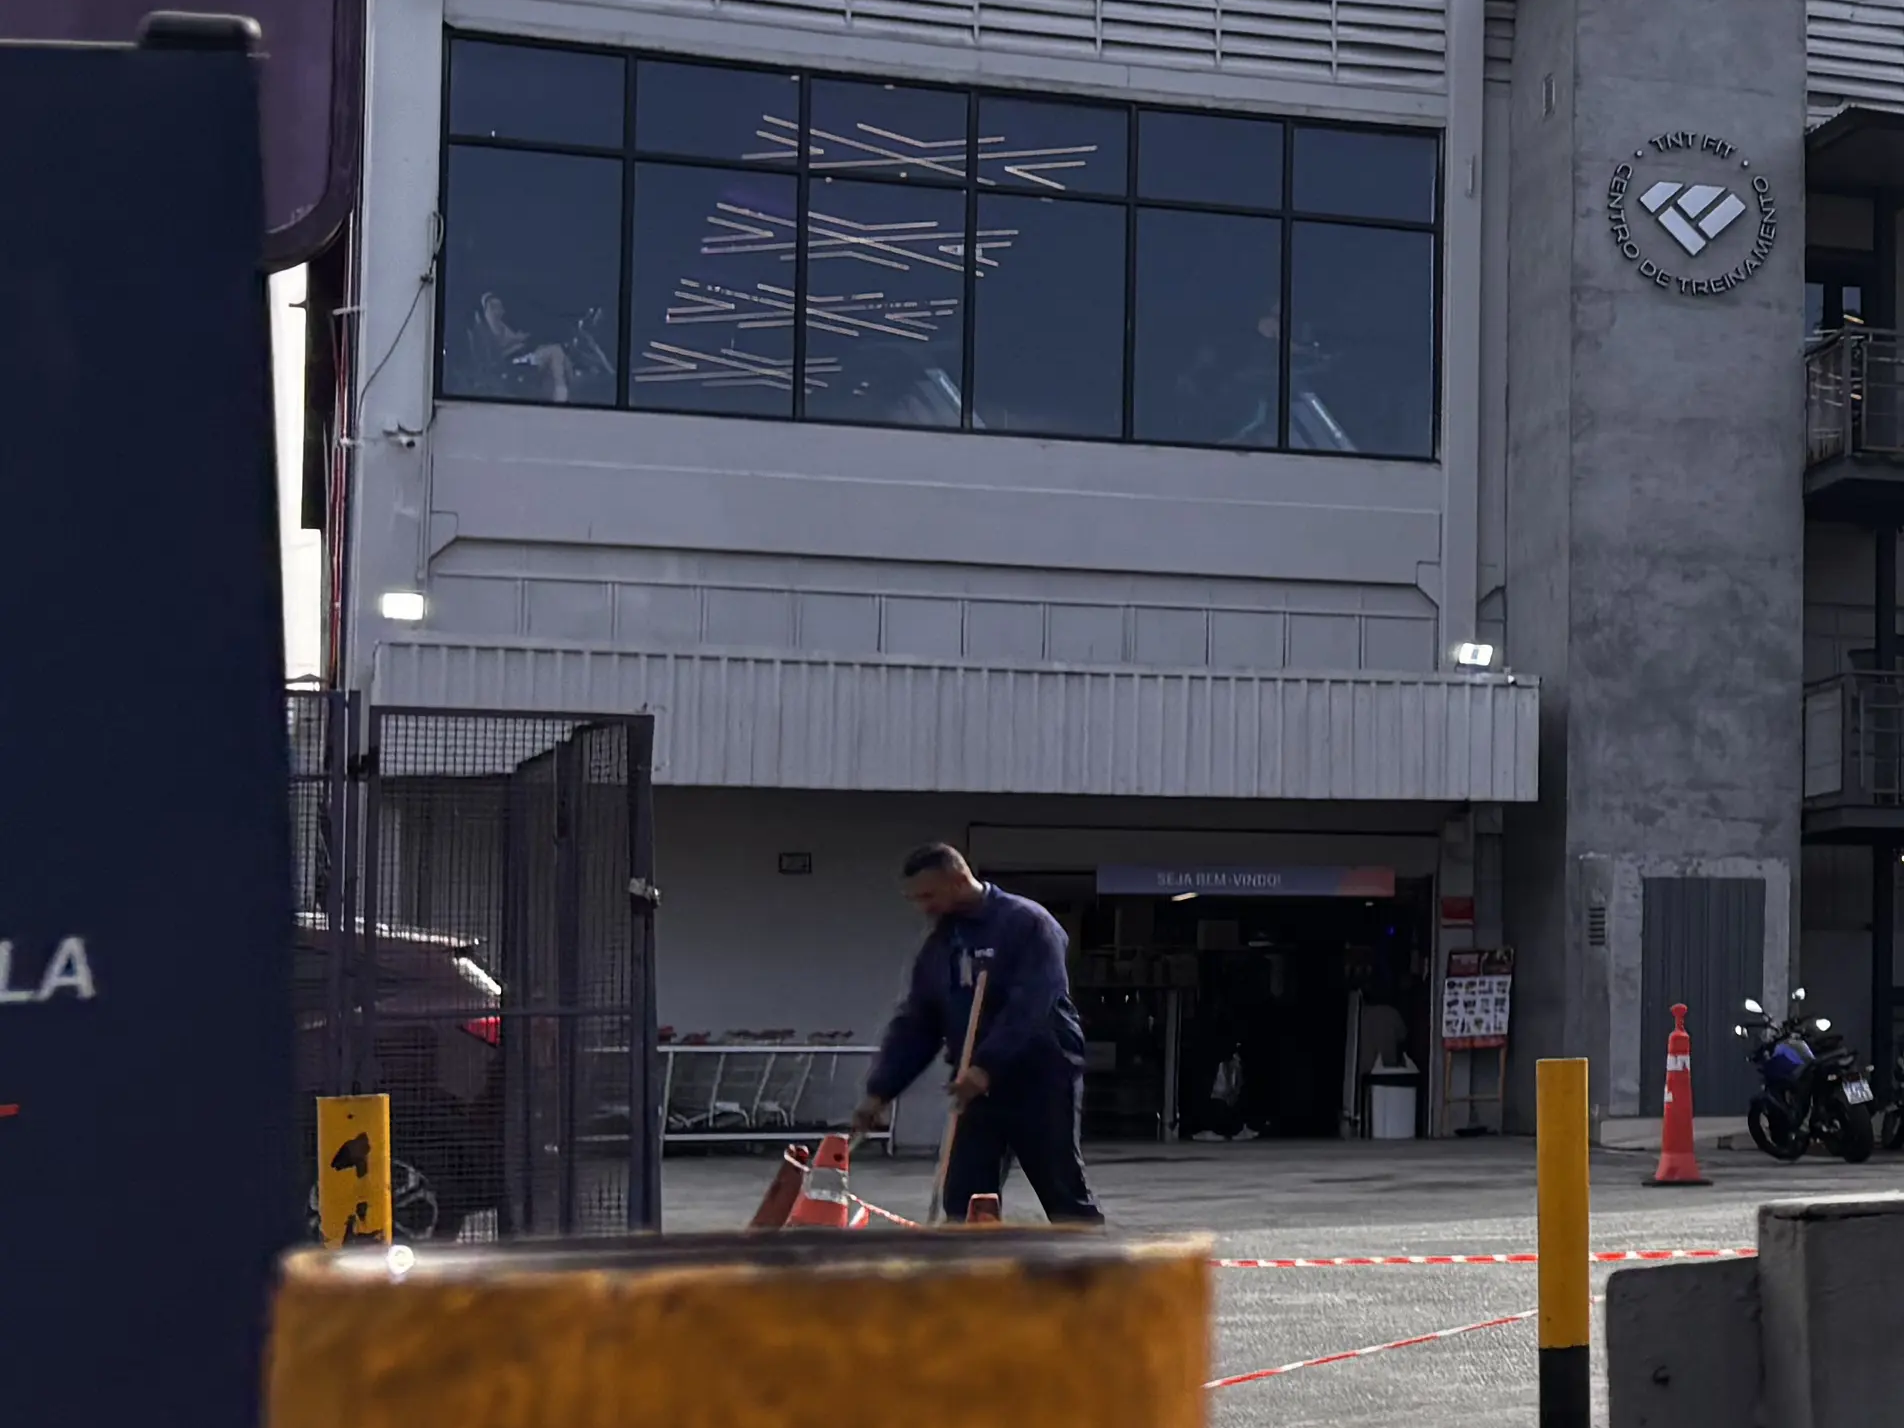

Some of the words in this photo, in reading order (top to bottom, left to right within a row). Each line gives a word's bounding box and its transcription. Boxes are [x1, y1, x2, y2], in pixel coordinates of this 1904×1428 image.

[1648, 131, 1697, 152] TNT
[1701, 133, 1737, 159] FIT
[1607, 162, 1641, 259] CENTRO
[1639, 259, 1673, 287] DE
[1676, 175, 1778, 296] TREINAMENTO
[0, 937, 96, 1002] LA
